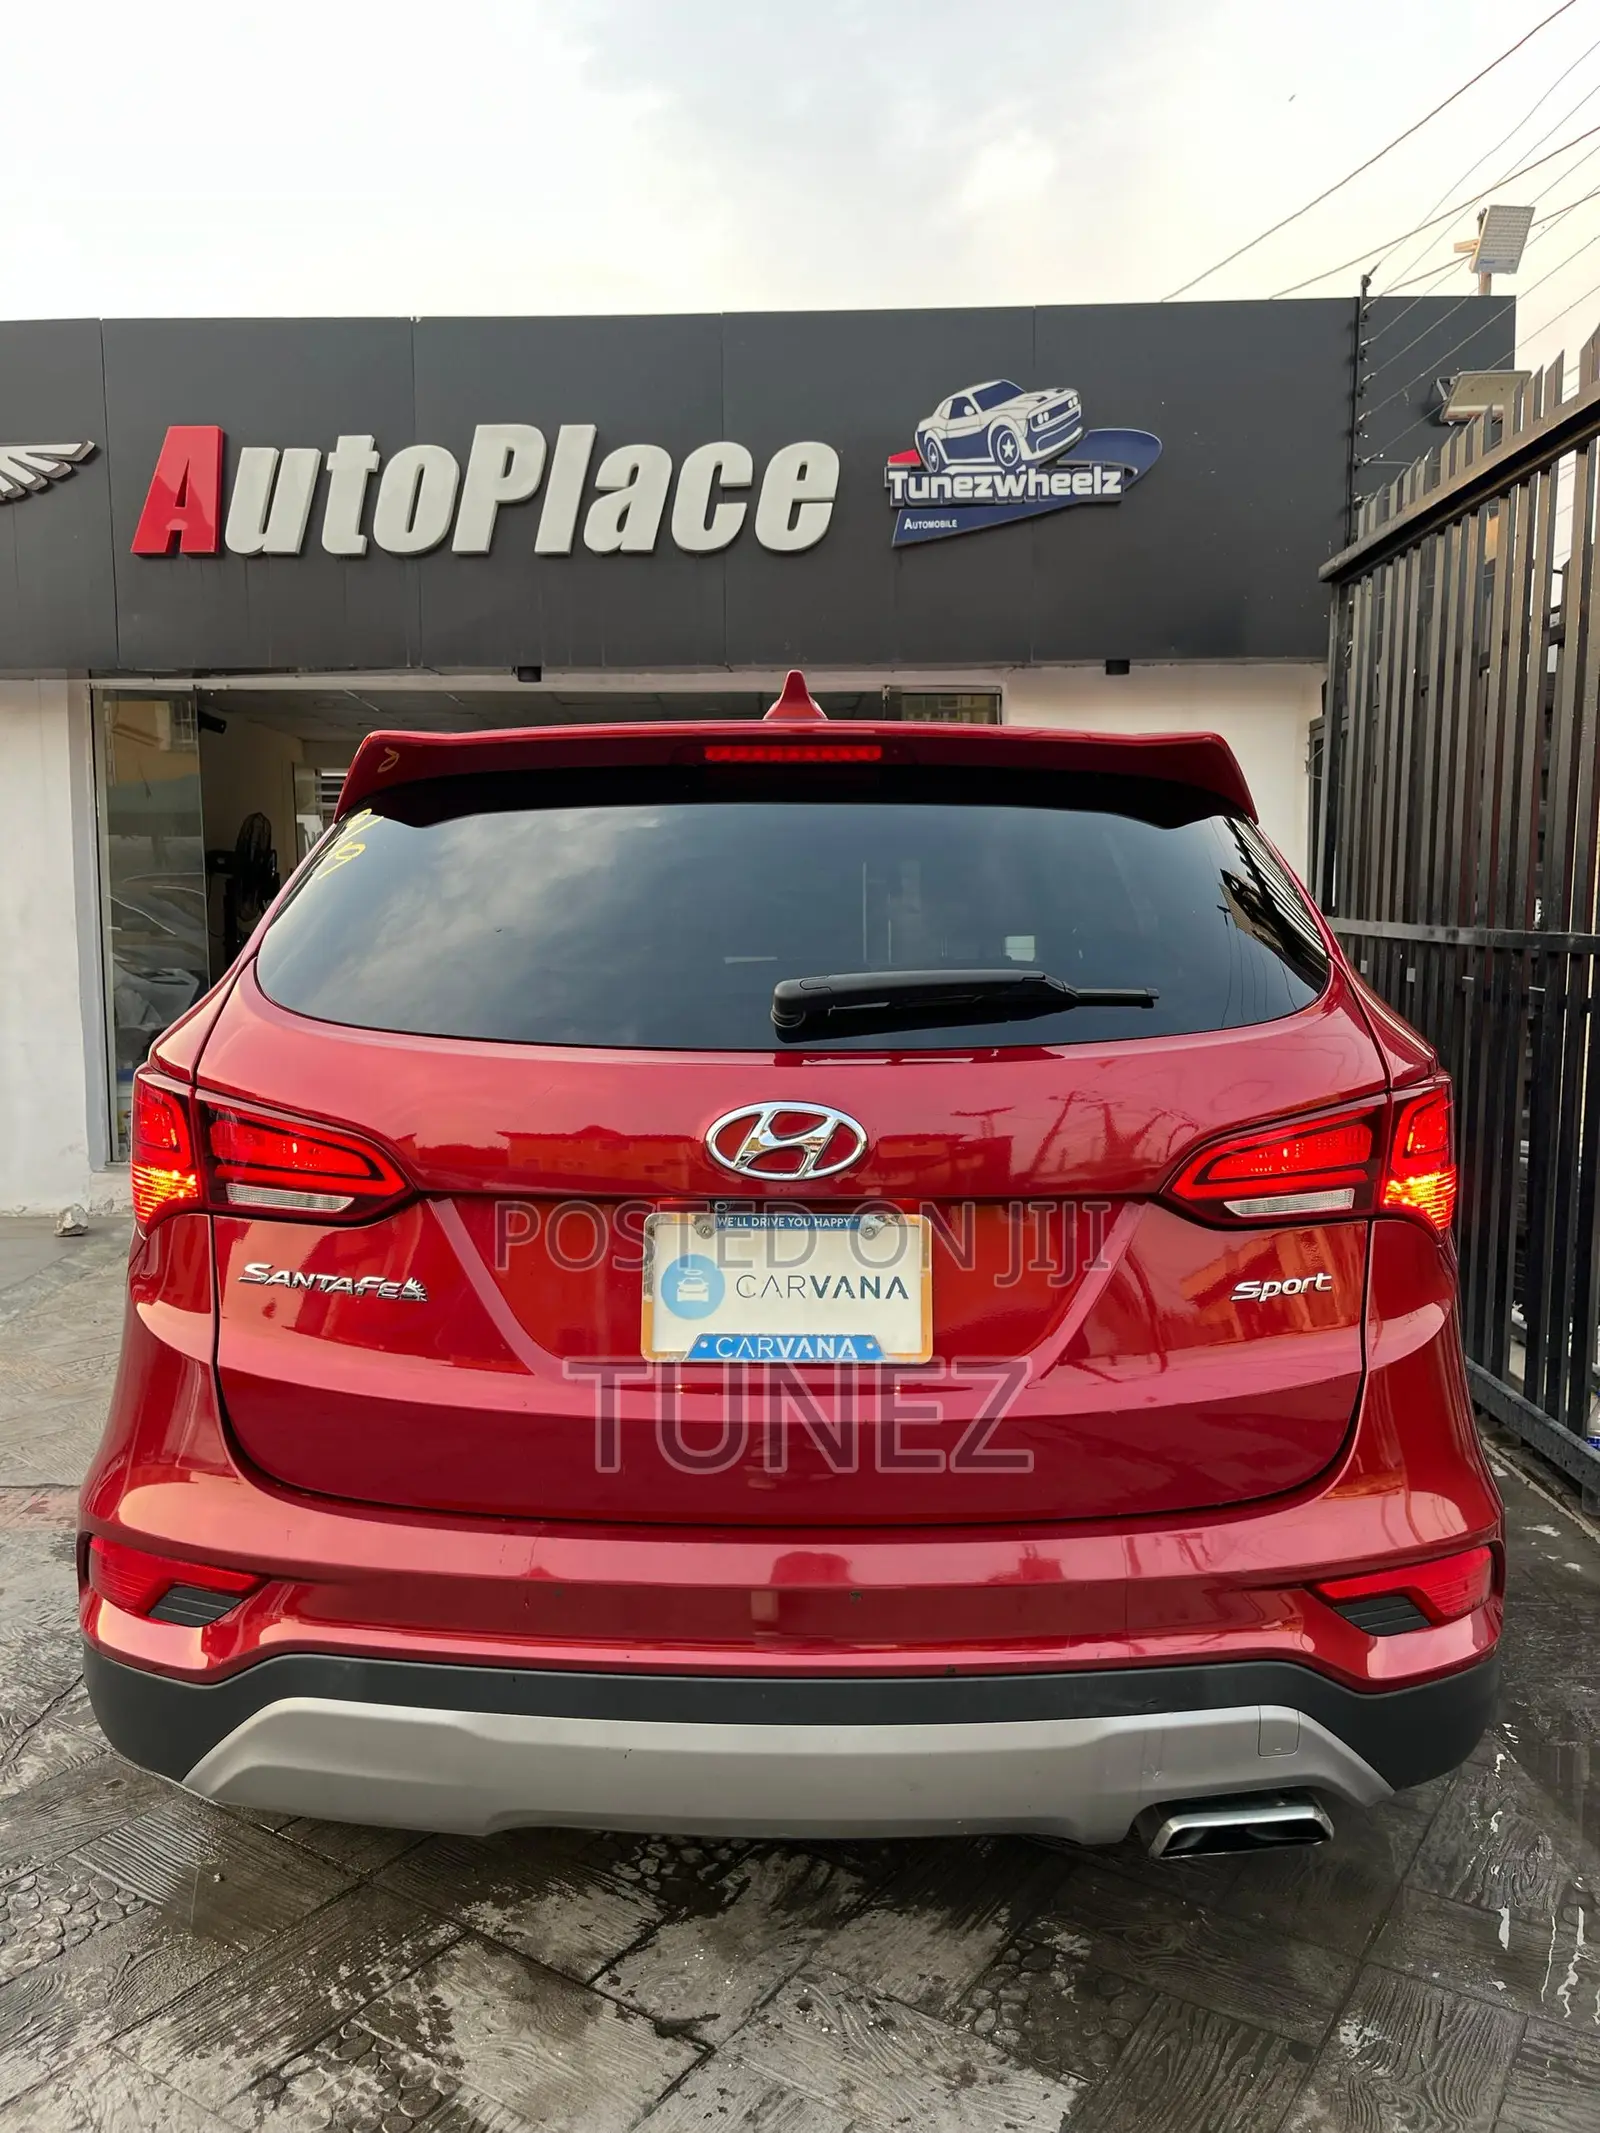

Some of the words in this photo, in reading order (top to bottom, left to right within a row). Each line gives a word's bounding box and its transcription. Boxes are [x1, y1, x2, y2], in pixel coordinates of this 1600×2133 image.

[131, 424, 841, 556] AutoPlace
[717, 1217, 749, 1228] WE'LL
[751, 1217, 785, 1228] DRIVE
[787, 1217, 811, 1228] YOU
[736, 1274, 910, 1300] CARVANA
[1230, 1272, 1333, 1302] Sport
[715, 1336, 859, 1359] CARVANA
